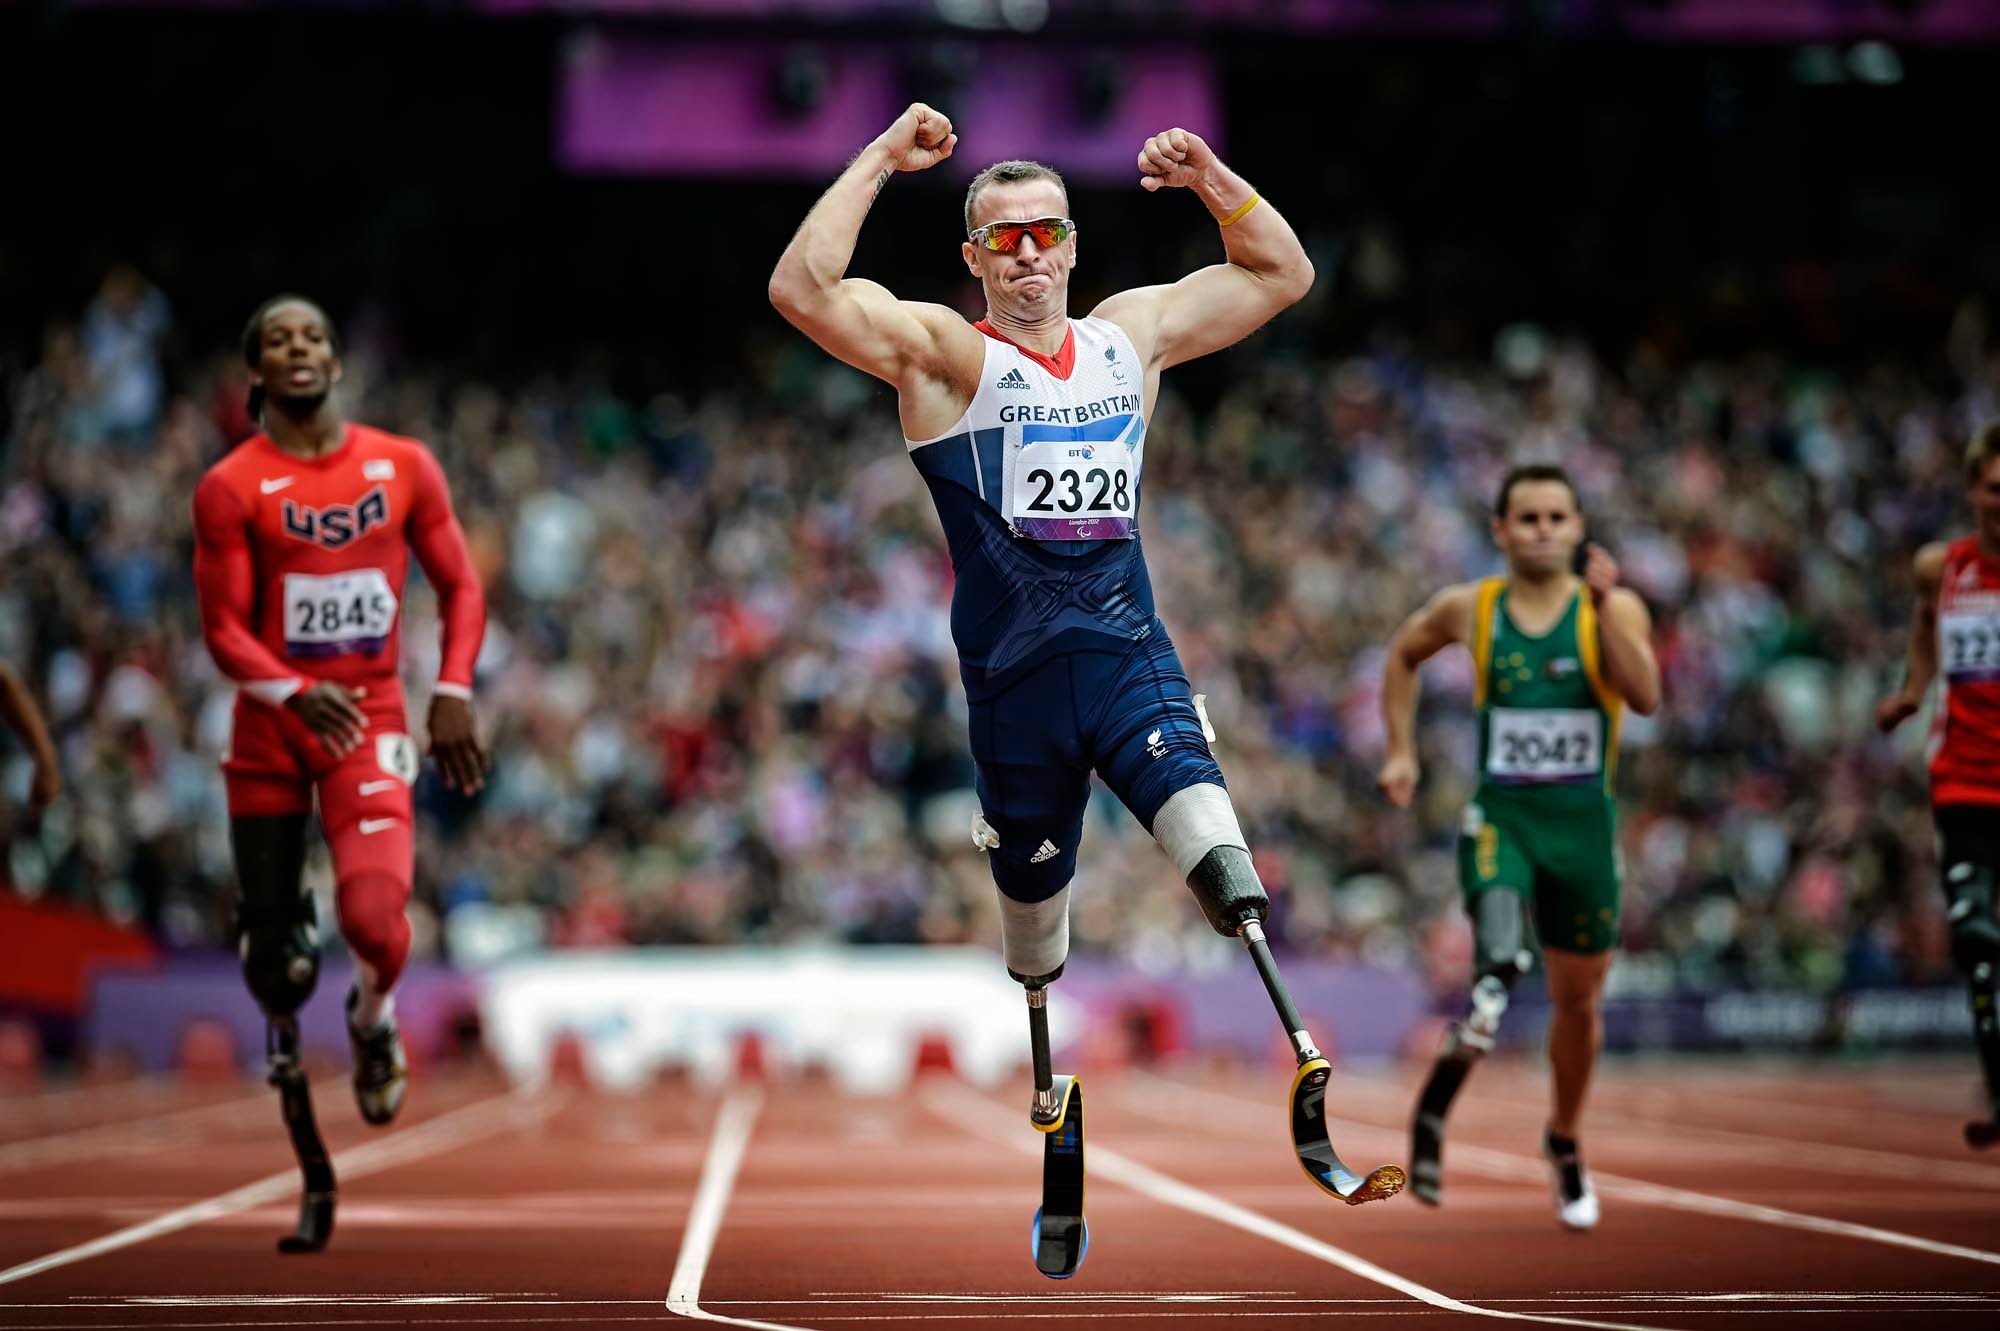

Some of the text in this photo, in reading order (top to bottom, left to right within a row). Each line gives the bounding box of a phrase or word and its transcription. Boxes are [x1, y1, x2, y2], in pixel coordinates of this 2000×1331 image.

[997, 380, 1031, 390] adidas
[1000, 394, 1141, 424] GREAT BRITAIN
[1068, 449, 1081, 457] BT
[1026, 468, 1131, 513] 2328
[282, 485, 389, 550] USA
[295, 593, 387, 634] 2845
[1947, 626, 2000, 664] 22
[1502, 730, 1592, 767] 2042
[1030, 848, 1060, 863] adidas
